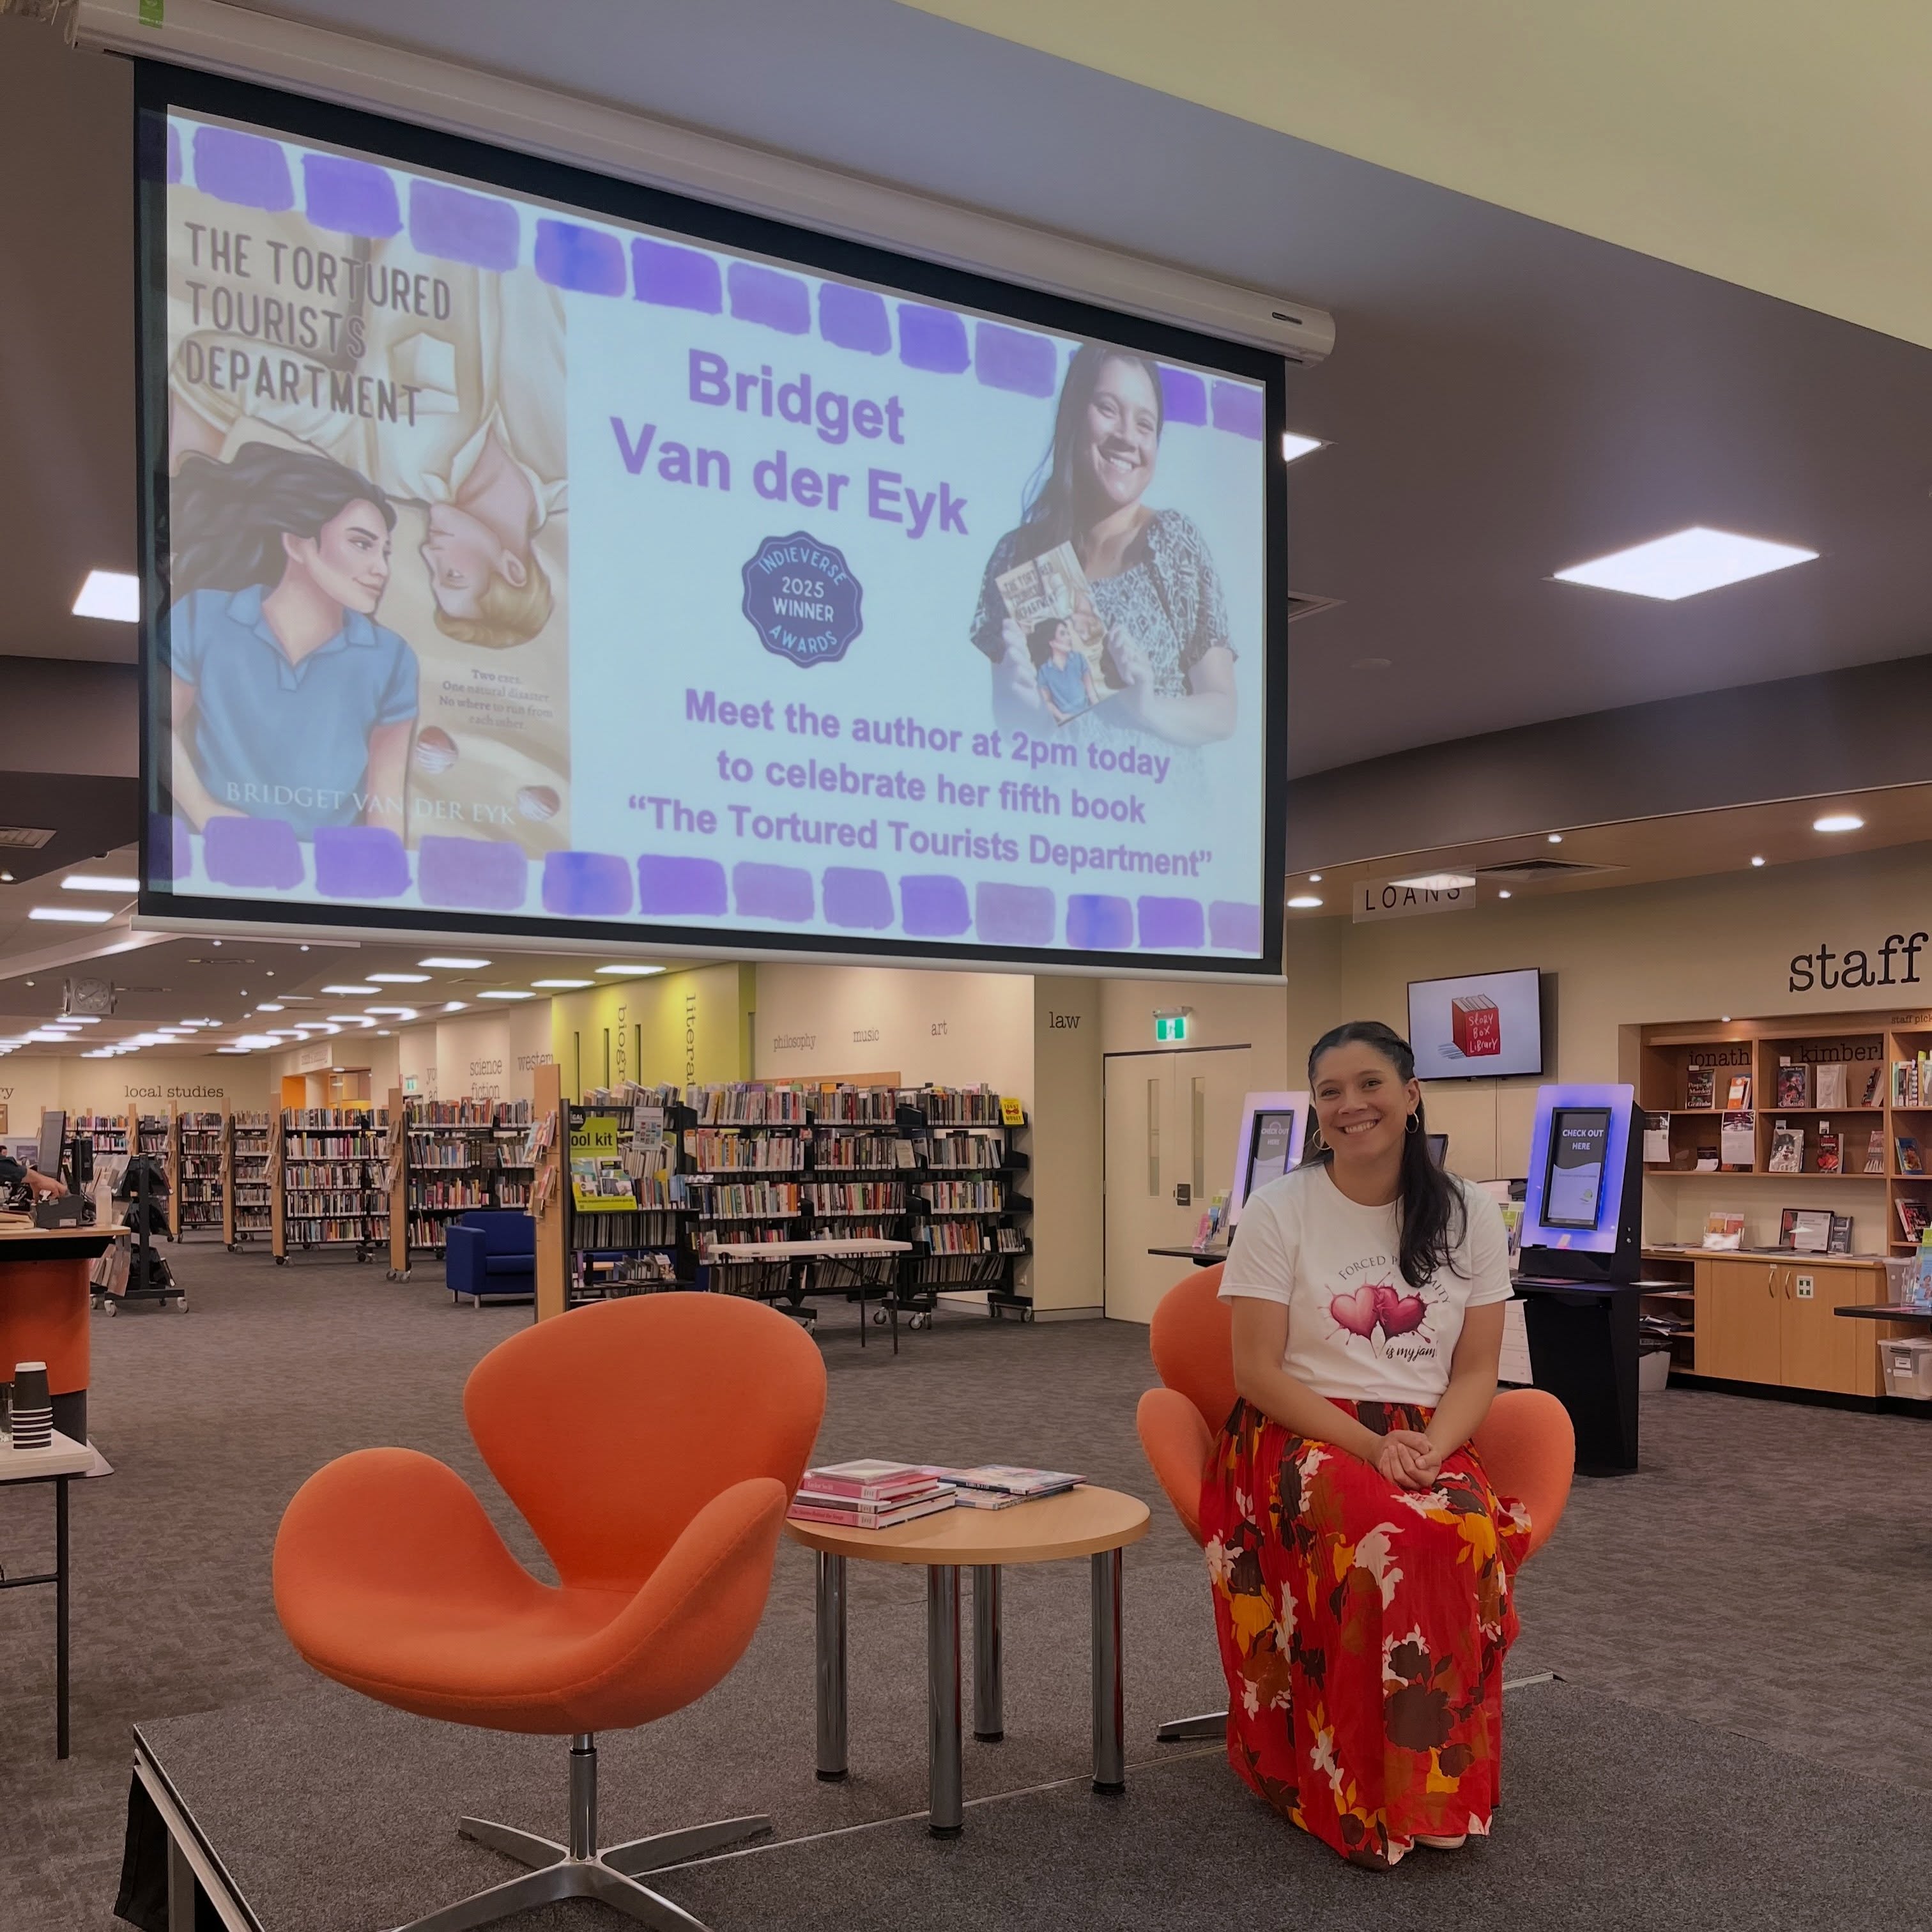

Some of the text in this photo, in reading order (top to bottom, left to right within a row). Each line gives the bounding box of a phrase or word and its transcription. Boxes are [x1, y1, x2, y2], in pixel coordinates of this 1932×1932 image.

[185, 222, 450, 320] THE TORTURED
[185, 280, 366, 358] TOURISTS
[185, 340, 422, 427] DEPARTMENT
[689, 348, 905, 445] Bridget
[609, 415, 969, 540] Van der Eyk
[758, 546, 847, 586] INDIEVERSE
[781, 576, 825, 599] 2025
[772, 597, 834, 623] WINNER
[769, 624, 838, 654] AWARDS
[471, 669, 495, 681] Two
[443, 680, 464, 692] One
[467, 685, 506, 697] natural
[440, 695, 455, 707] No
[457, 698, 491, 711] where
[493, 703, 504, 712] to
[527, 705, 553, 717] from
[686, 689, 1171, 784] Meet the author at 2pm today
[717, 750, 1146, 825] to celebrate her fifth book
[226, 781, 518, 826] BRIDGET VAN DER EYK
[628, 795, 1213, 878] “The Tortured Tourists Department”
[1365, 876, 1461, 911] LOANS
[1790, 931, 1929, 993] staff
[931, 1020, 948, 1036] art
[1048, 1011, 1081, 1029] law
[773, 1033, 816, 1052] philosophy
[853, 1027, 880, 1043] music
[470, 1057, 502, 1077] science
[125, 1085, 224, 1098] local studies
[470, 1082, 501, 1100] fiction
[595, 1133, 613, 1146] kit
[1338, 1255, 1386, 1281] FORCED
[1386, 1346, 1395, 1356] is
[1397, 1346, 1415, 1362] my
